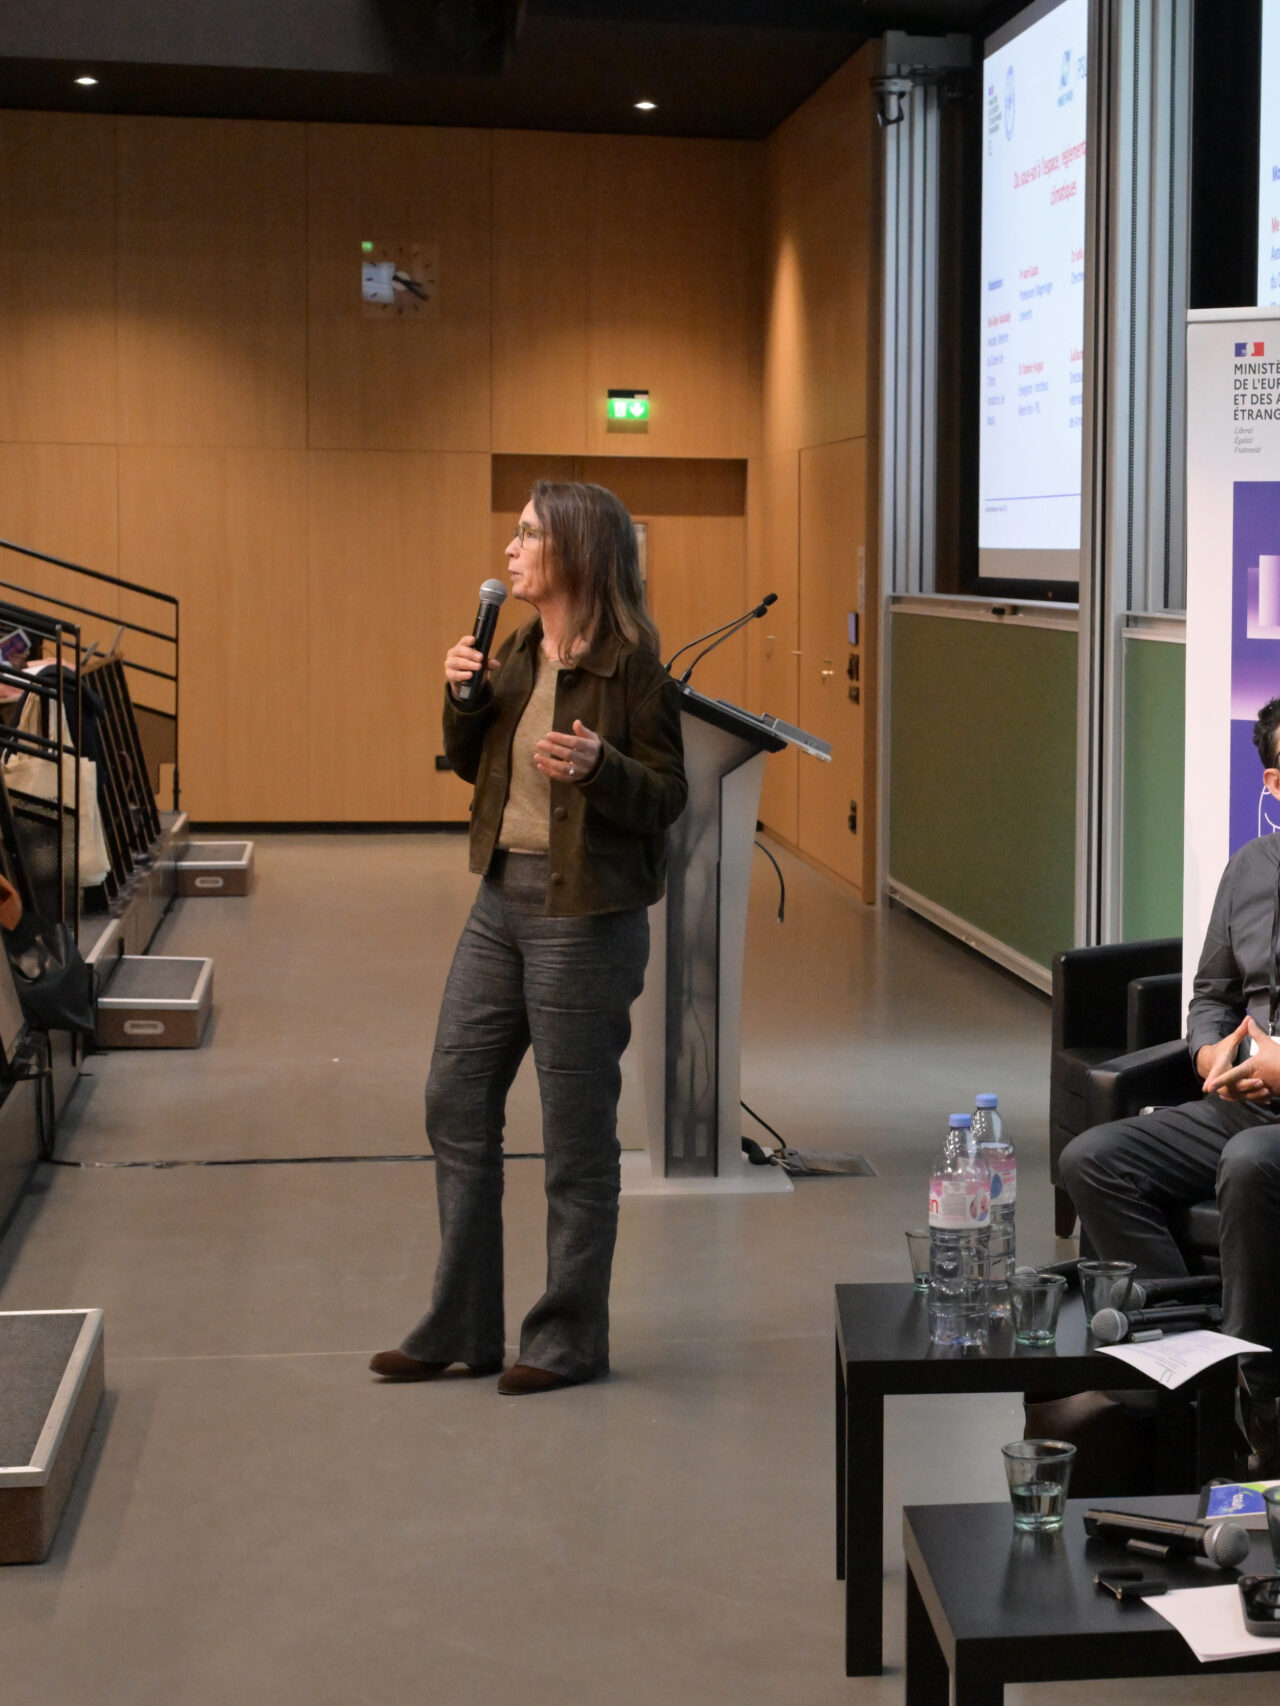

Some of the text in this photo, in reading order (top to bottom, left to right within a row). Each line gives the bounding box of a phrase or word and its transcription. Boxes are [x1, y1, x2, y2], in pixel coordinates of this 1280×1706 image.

[1234, 378, 1248, 390] DE
[1233, 394, 1247, 405] ET
[1250, 393, 1273, 405] DES
